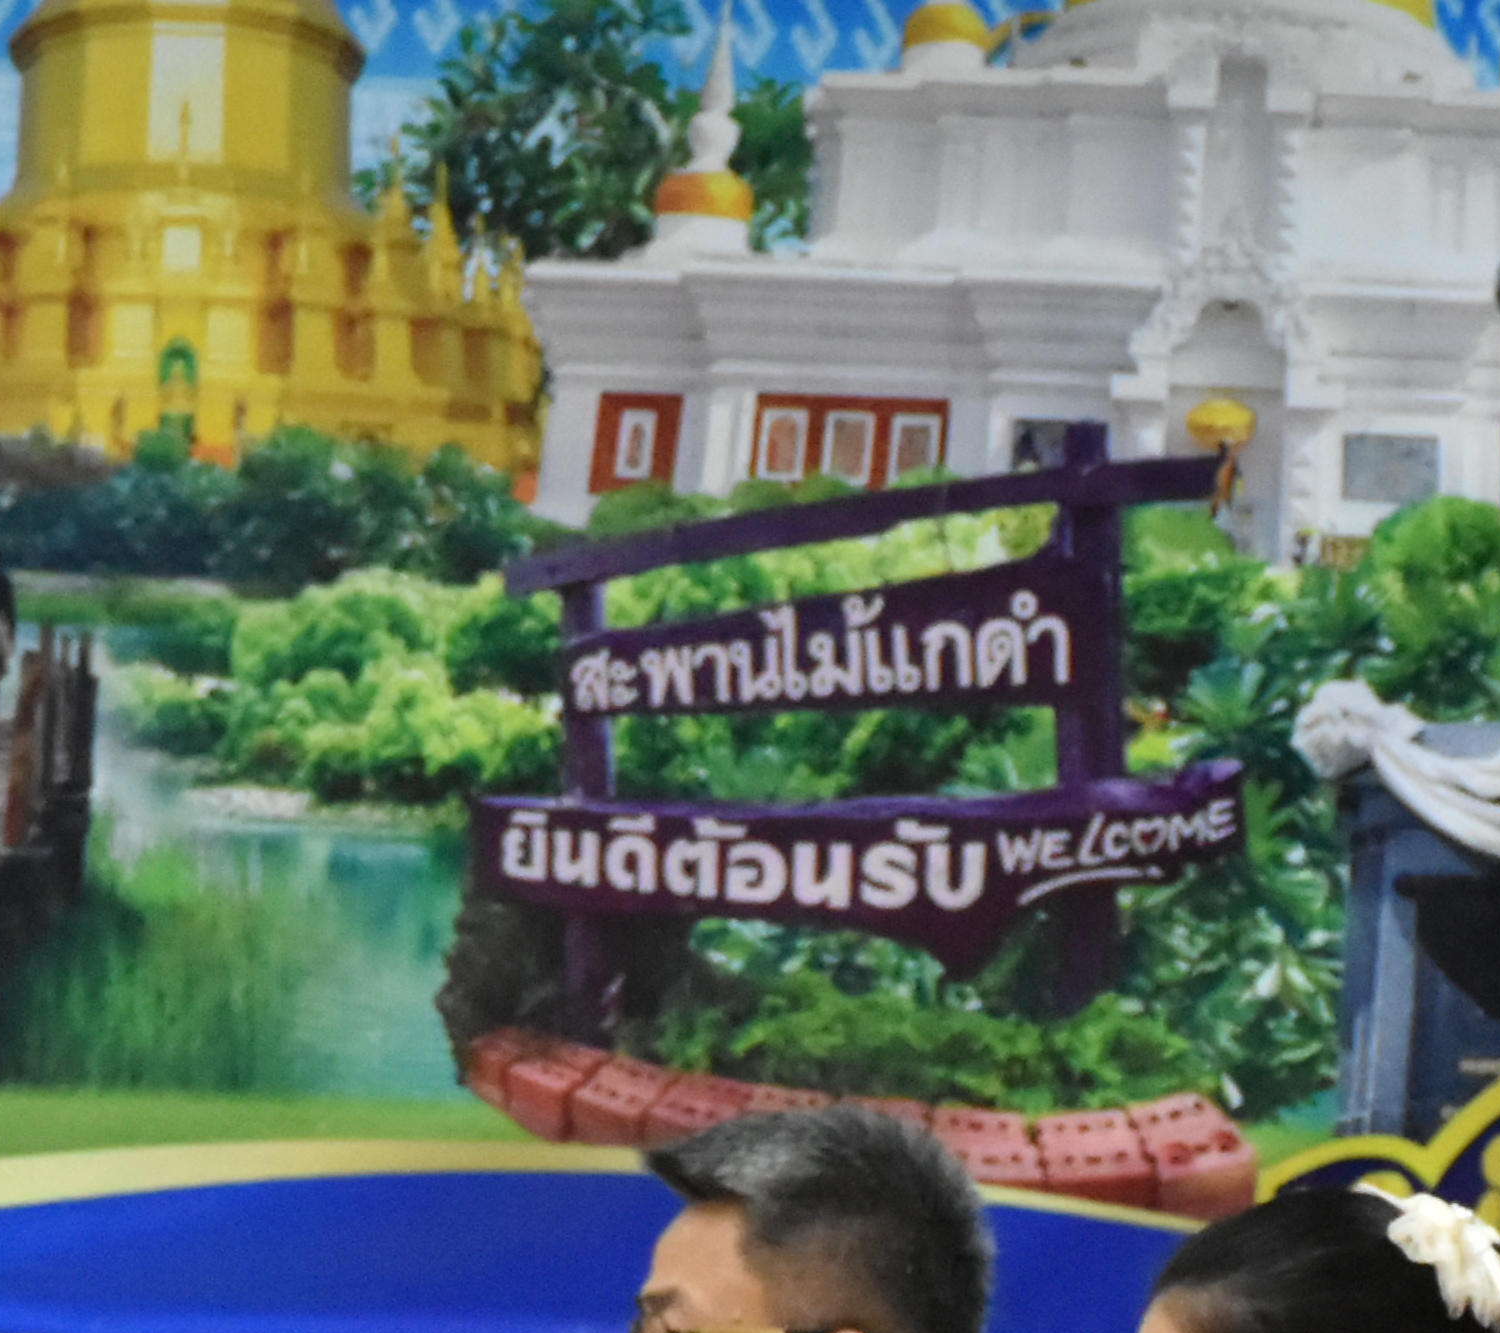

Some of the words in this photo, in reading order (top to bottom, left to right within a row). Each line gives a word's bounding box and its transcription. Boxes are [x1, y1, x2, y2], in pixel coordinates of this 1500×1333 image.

[570, 590, 1072, 712] สะพานไม้แกดำ
[501, 812, 988, 911] ยินดีต้อนรับ
